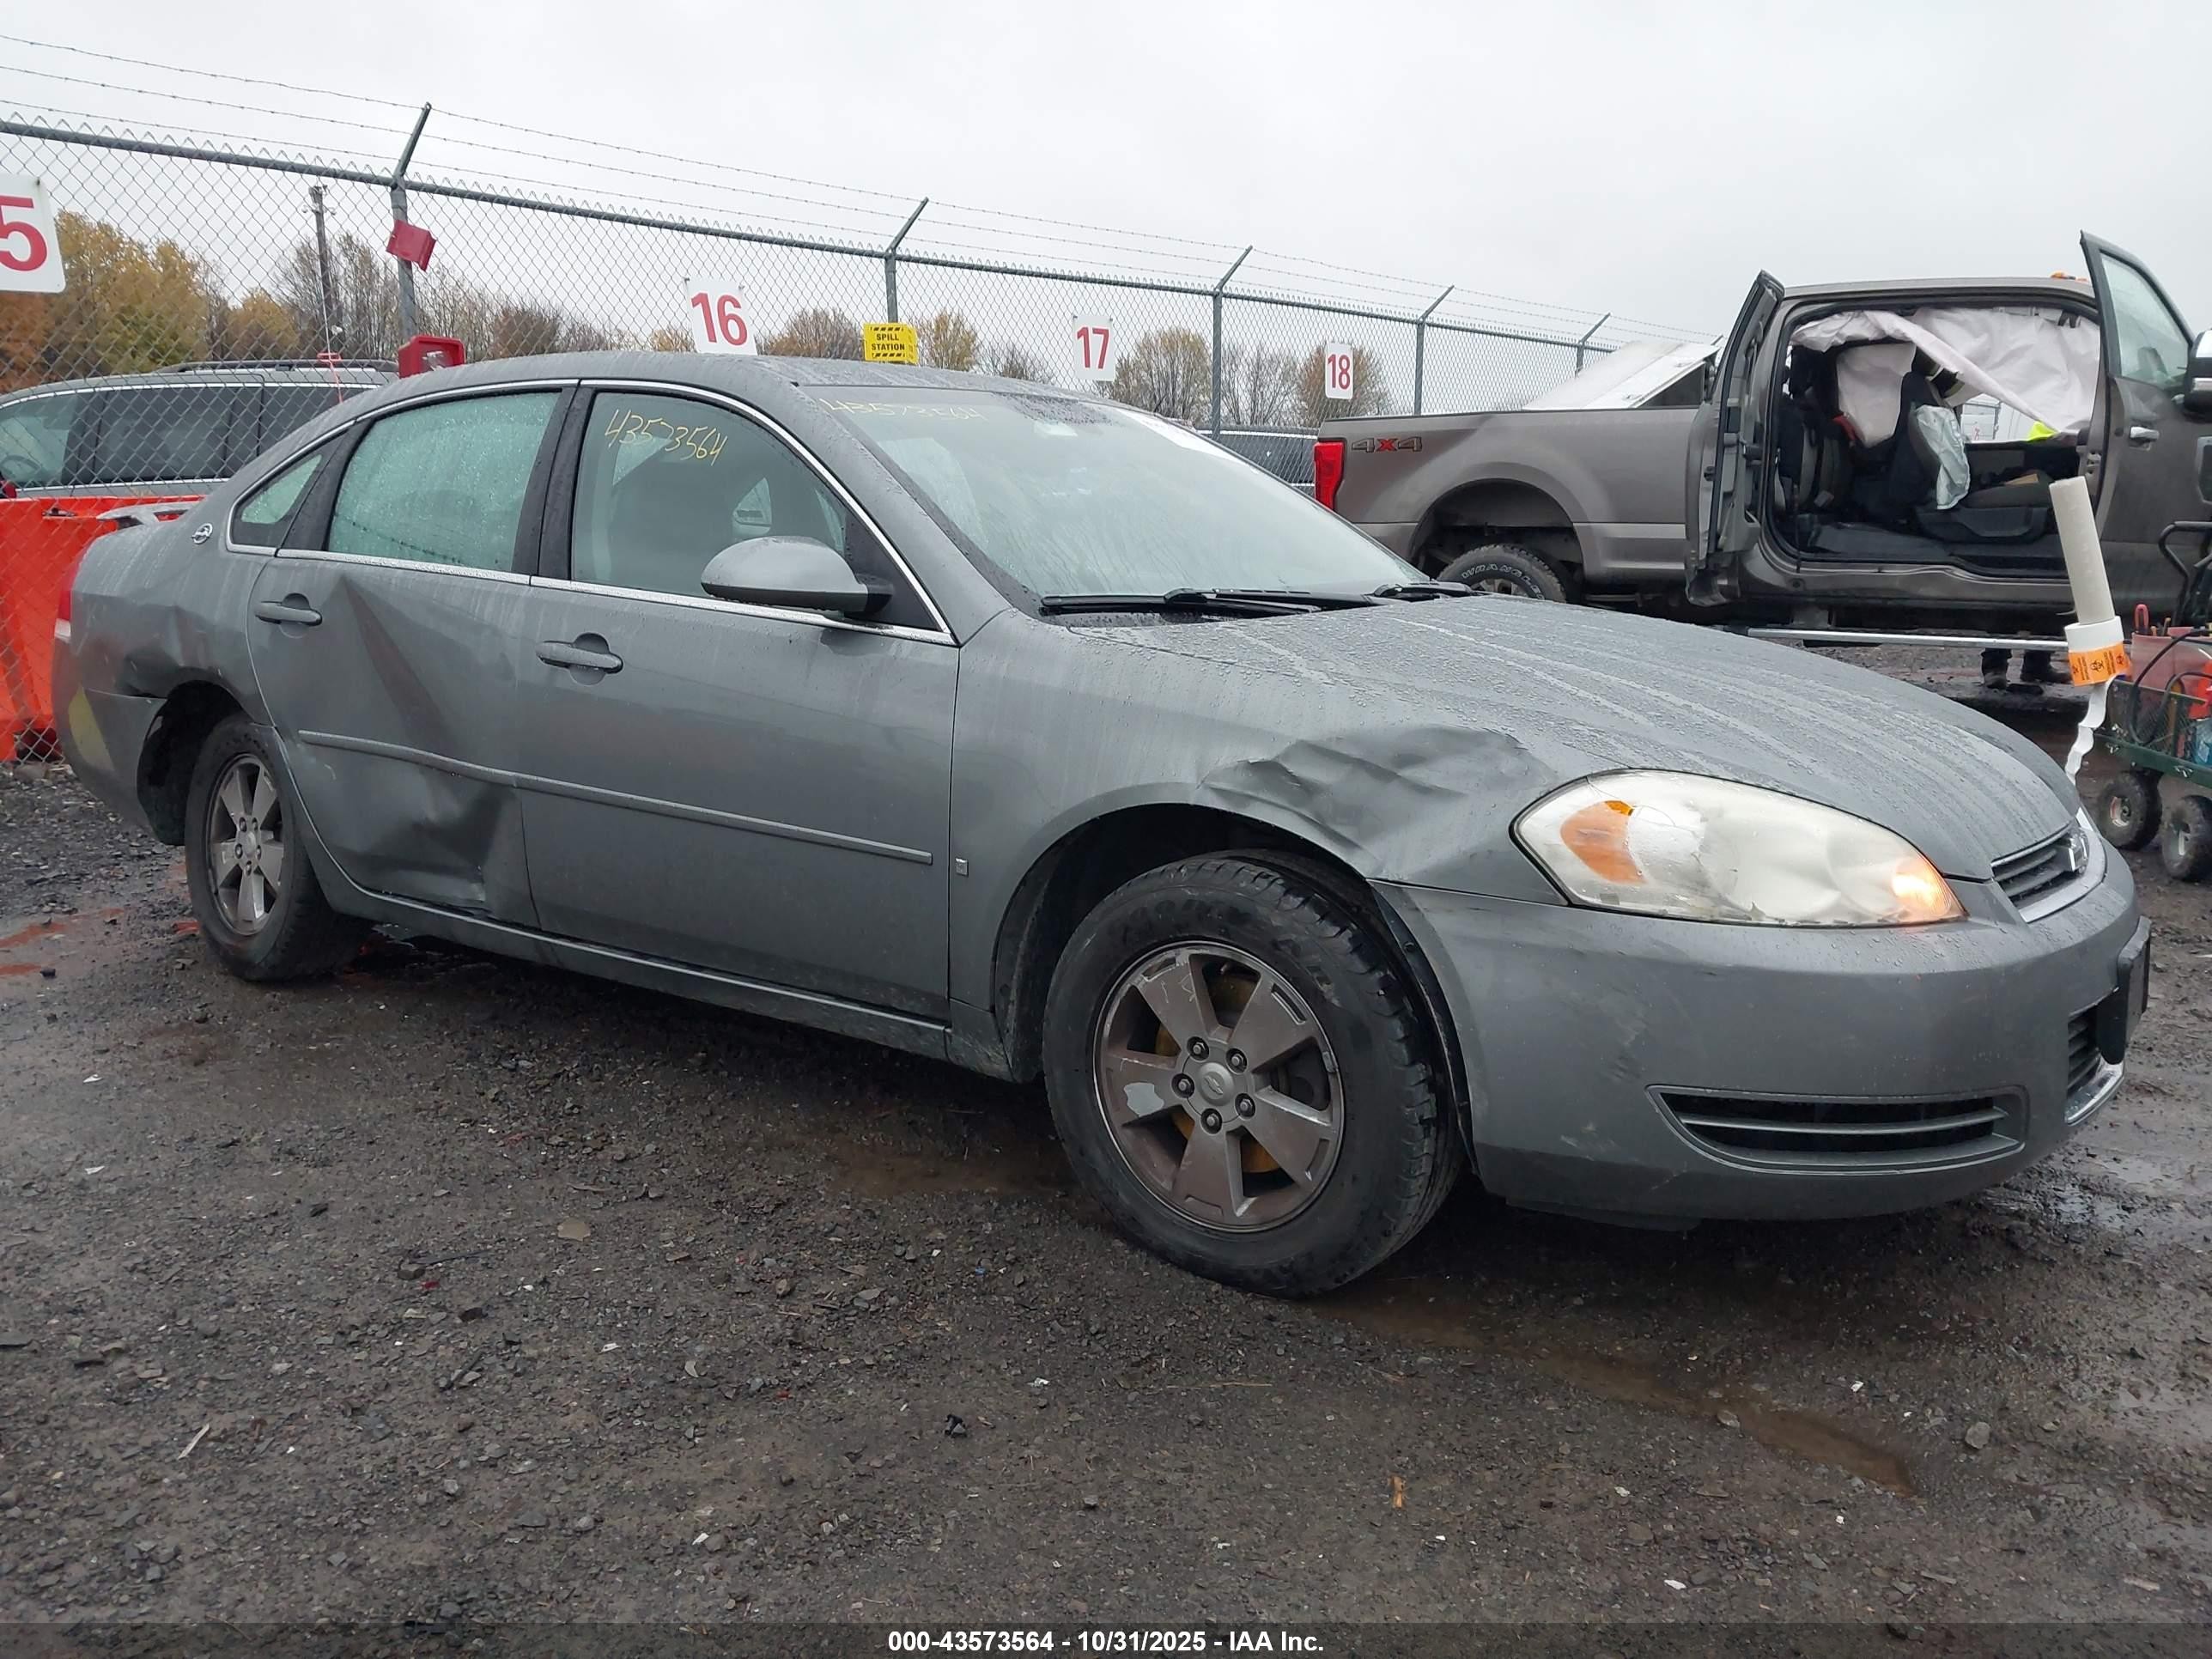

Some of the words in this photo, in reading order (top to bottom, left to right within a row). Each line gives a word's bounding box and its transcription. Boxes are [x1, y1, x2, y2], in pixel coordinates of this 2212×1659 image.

[690, 292, 748, 346] 16
[876, 332, 899, 341] SPILL
[1077, 326, 1109, 369] 17
[1328, 354, 1351, 390] 18
[605, 409, 728, 466] 43573564
